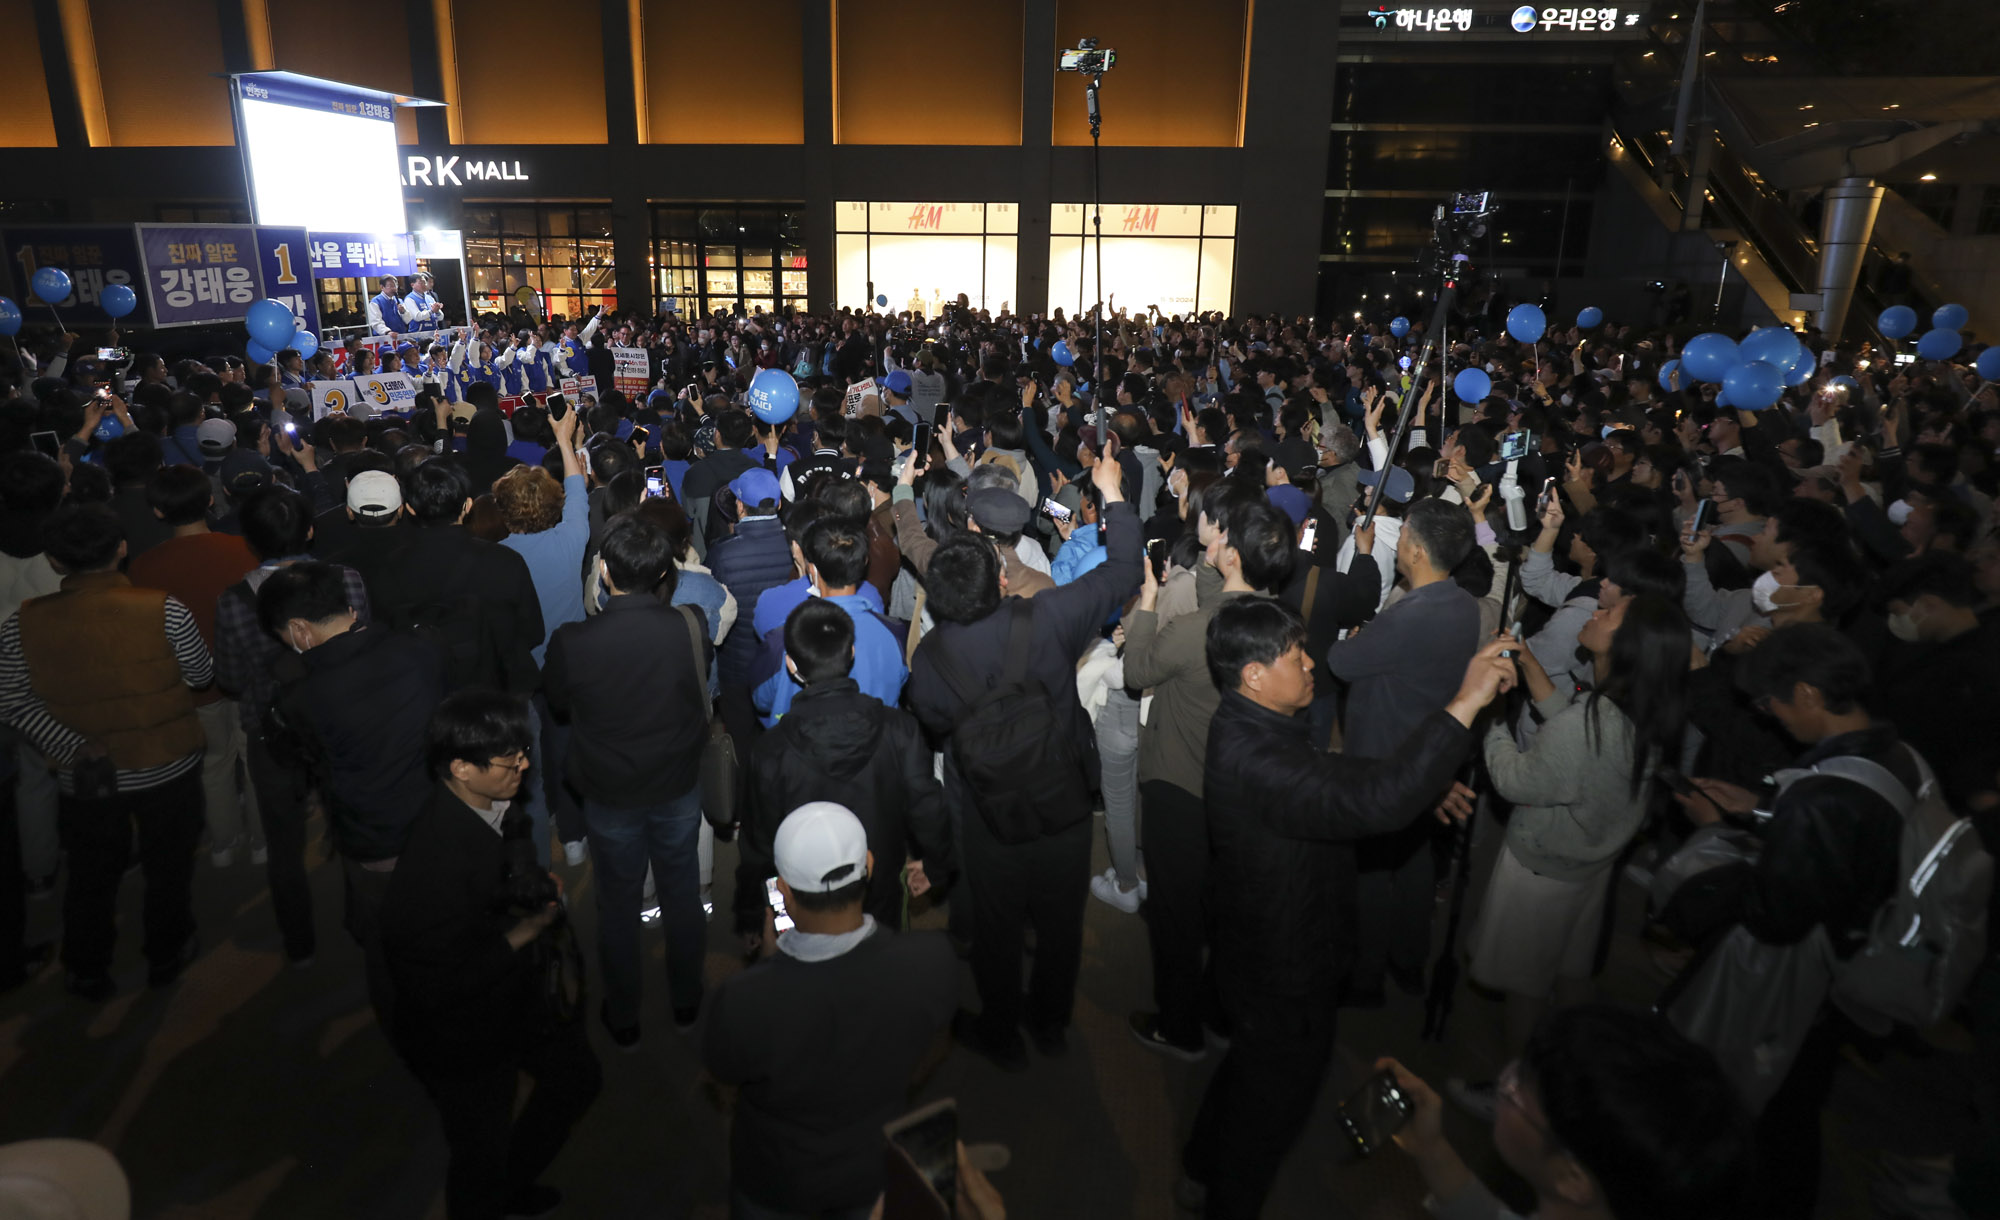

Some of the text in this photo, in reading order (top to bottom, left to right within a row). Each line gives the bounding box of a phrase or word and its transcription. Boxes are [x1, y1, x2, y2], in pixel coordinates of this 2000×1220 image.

[1396, 8, 1473, 31] 하나은행
[1538, 7, 1618, 31] 우리은행
[245, 85, 269, 99] 민주당
[400, 155, 530, 187] RK MALL
[908, 205, 943, 230] H&M
[1122, 207, 1160, 232] H&M
[168, 243, 238, 264] 진짜 일꾼
[273, 243, 298, 285] 1
[160, 266, 255, 308] 강태웅
[368, 380, 391, 405] 3
